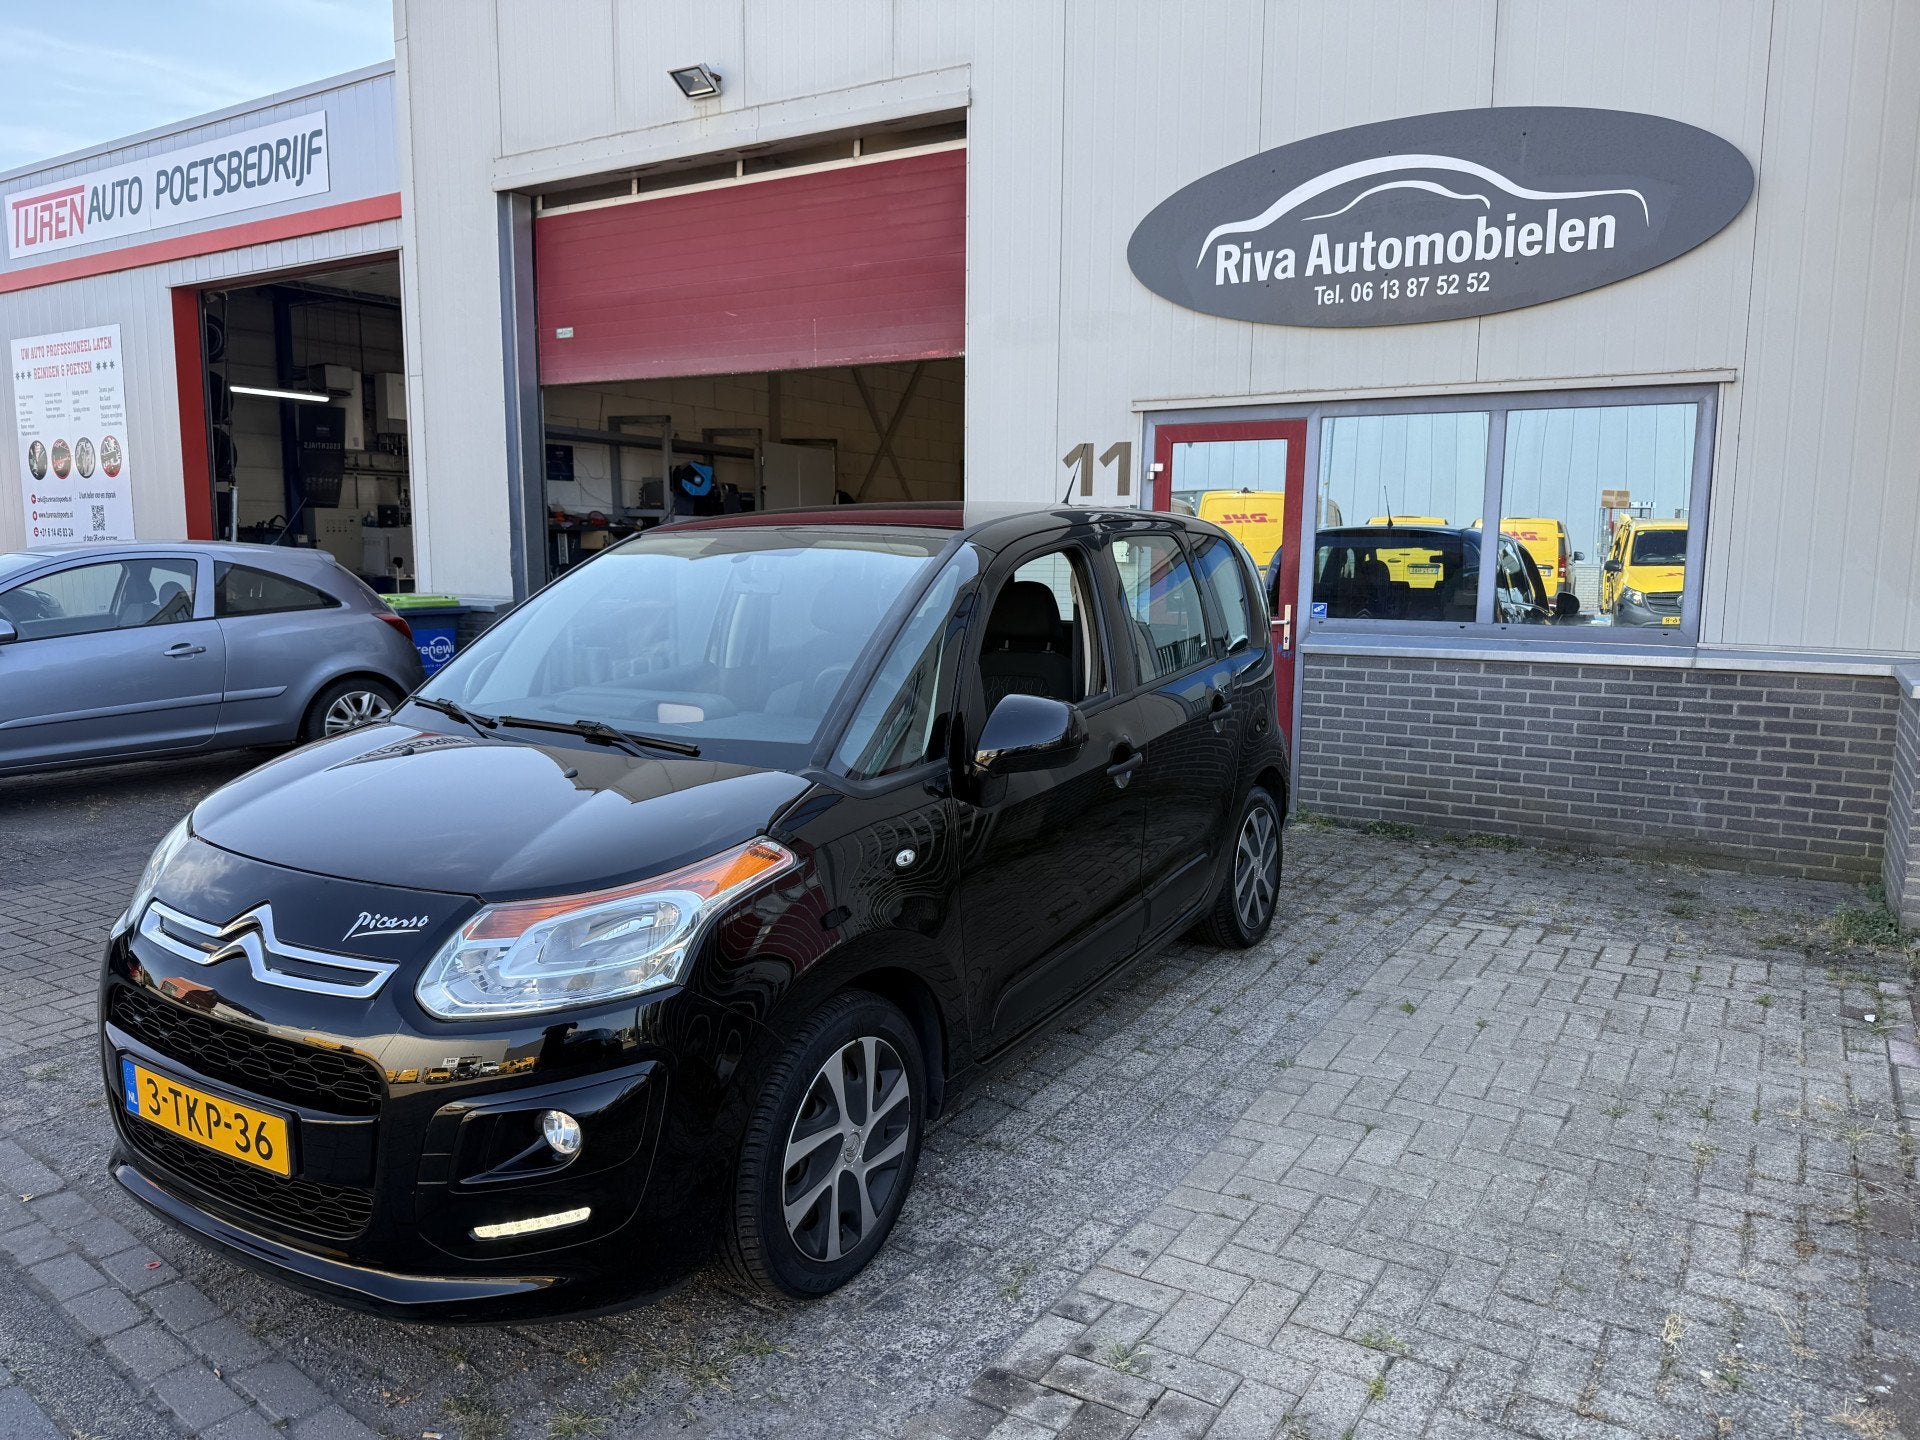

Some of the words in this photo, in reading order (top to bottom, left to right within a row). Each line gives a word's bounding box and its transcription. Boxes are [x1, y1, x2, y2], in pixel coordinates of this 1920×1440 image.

[12, 185, 85, 248] TUREN
[87, 176, 143, 225] AUTO
[155, 128, 323, 210] POETSBEDRIJF
[1216, 242, 1296, 286] Riva
[1304, 208, 1616, 277] Automobielen
[1314, 285, 1345, 306] Tel.
[1350, 282, 1373, 303] 06
[1379, 279, 1400, 301] 13
[1406, 276, 1429, 298] 87
[1436, 273, 1459, 296] 52
[1466, 271, 1490, 293] 52
[31, 345, 45, 359] AUTO
[46, 339, 91, 357] PROFESSIONEEL
[93, 336, 112, 351] LATEN
[1062, 442, 1131, 497] 11
[342, 911, 430, 942] Picasso
[127, 1091, 138, 1105] NL
[146, 1077, 274, 1161] 3-TKP-36
